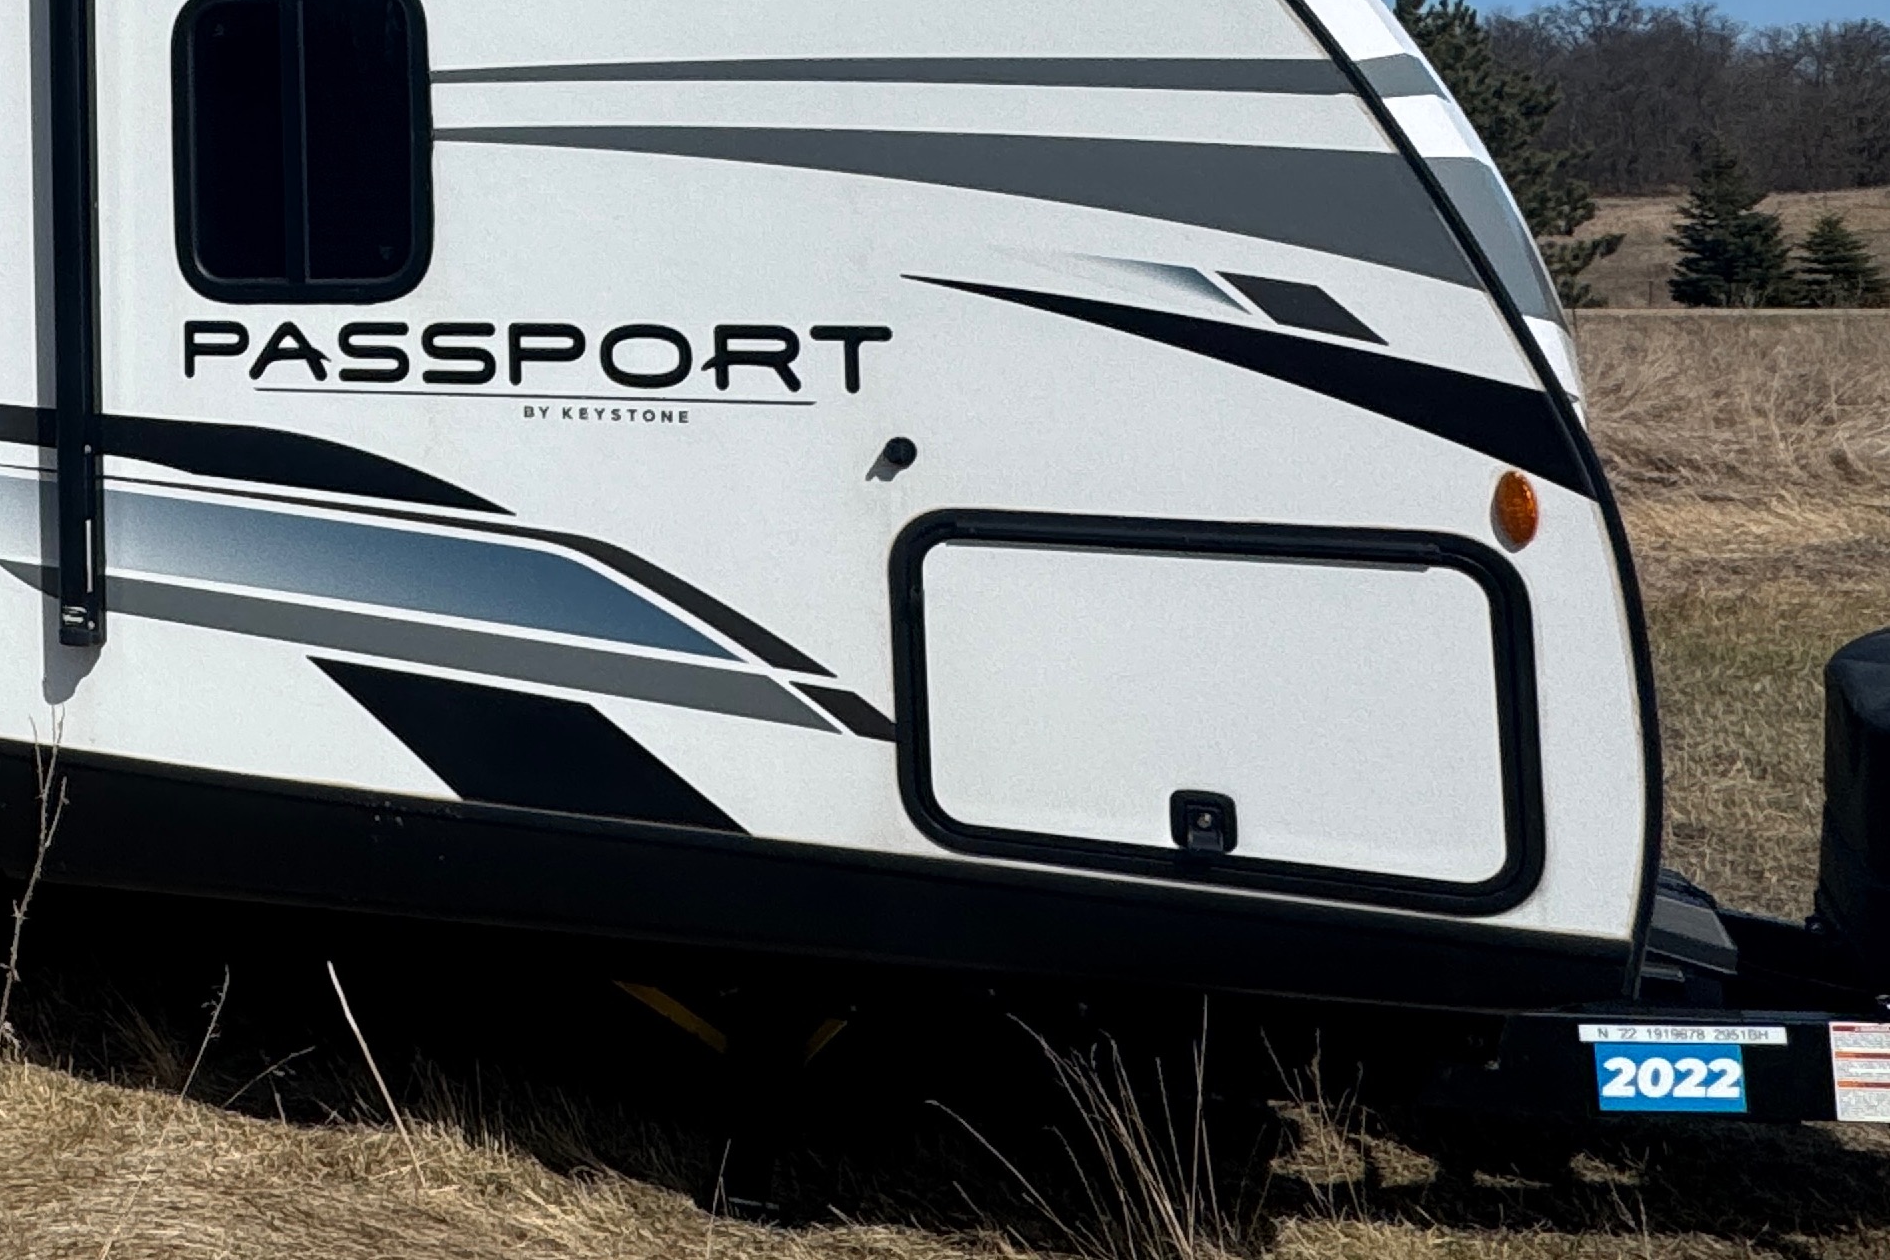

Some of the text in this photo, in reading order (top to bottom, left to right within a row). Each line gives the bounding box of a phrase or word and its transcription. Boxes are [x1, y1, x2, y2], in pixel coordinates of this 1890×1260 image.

[183, 320, 894, 394] PASSPORT
[523, 405, 690, 424] BY KEYSTONE
[1602, 1056, 1742, 1098] 2022
